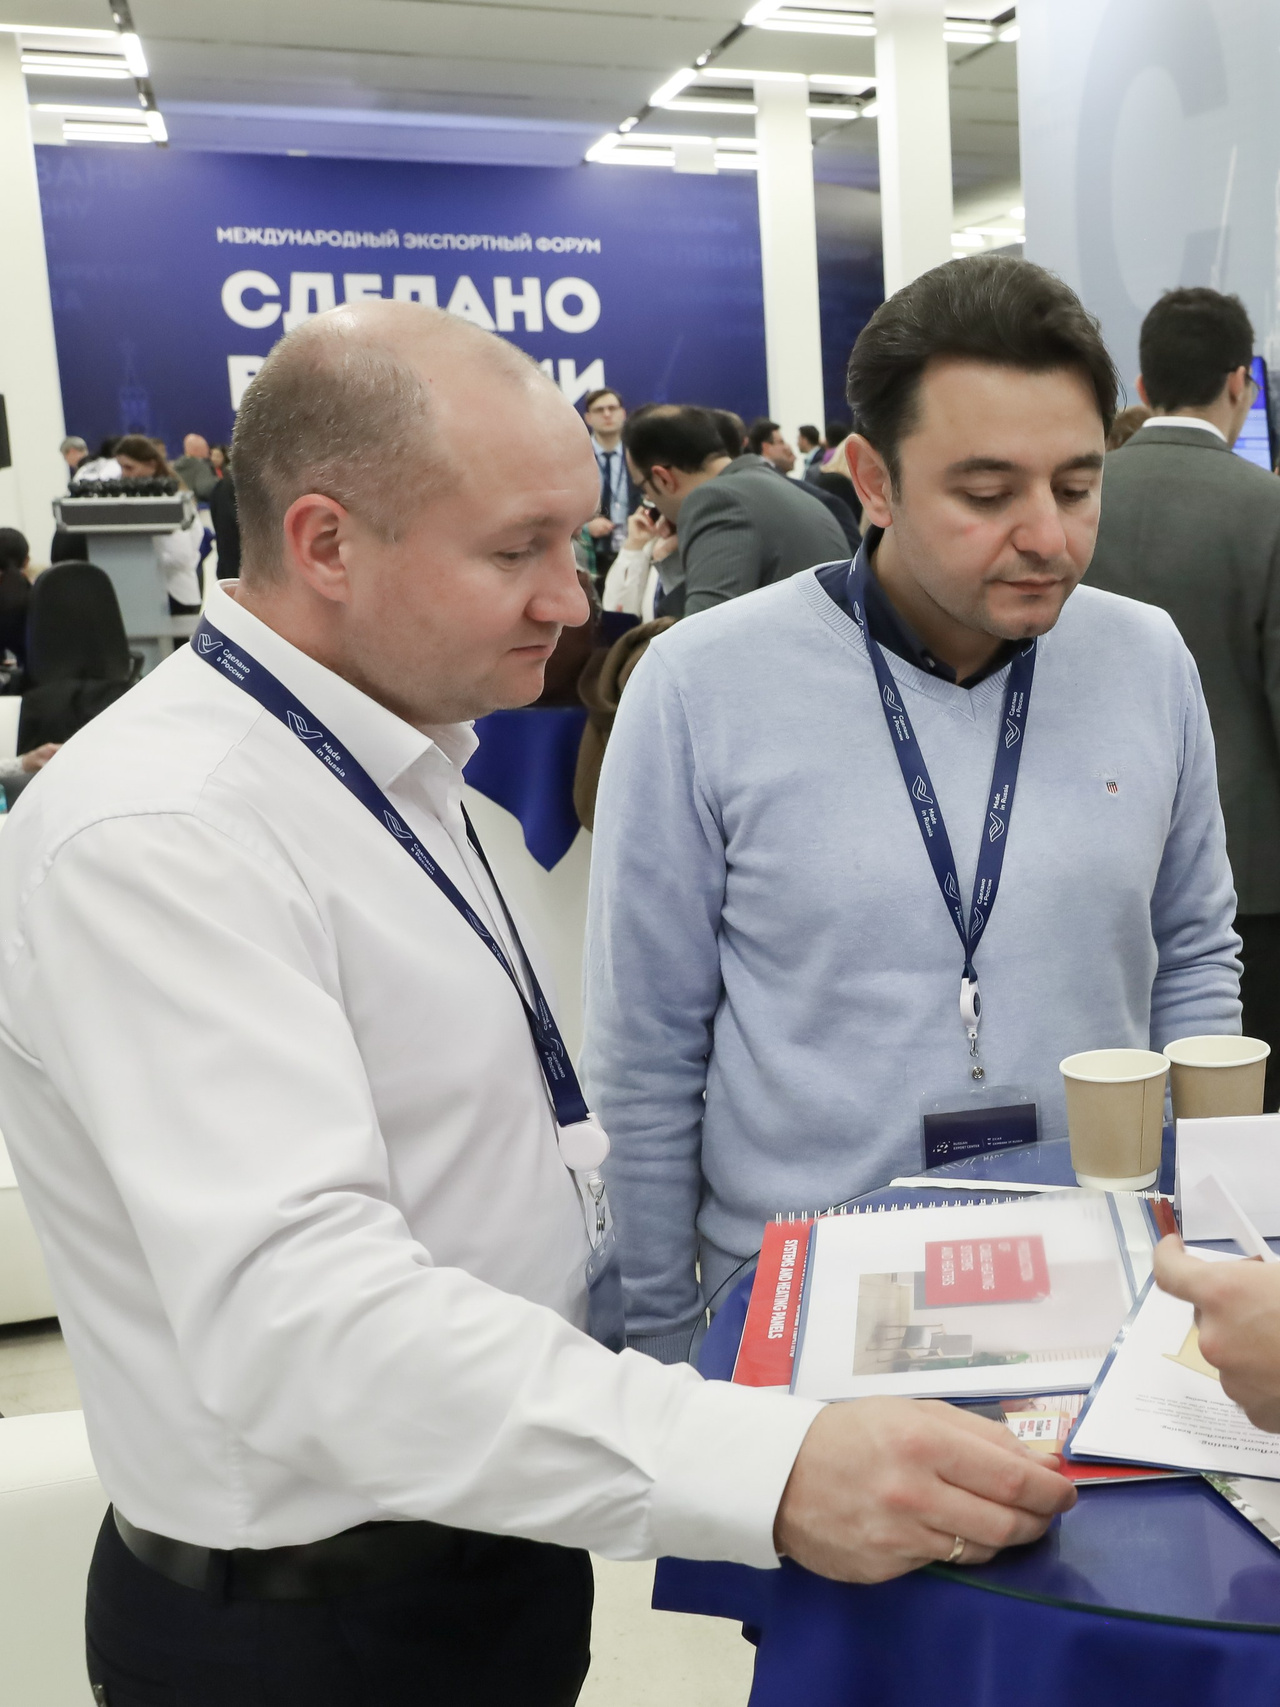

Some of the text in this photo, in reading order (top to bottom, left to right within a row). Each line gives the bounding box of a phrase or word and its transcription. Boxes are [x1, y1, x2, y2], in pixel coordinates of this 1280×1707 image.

[216, 226, 602, 254] МЕЖДУНАРОДНЫЙ ЭКСПОРТНЫЙ ФОРУМ
[221, 658, 245, 681] России
[222, 648, 251, 674] Сделано
[316, 747, 346, 778] in Russia
[322, 741, 341, 762] Made
[993, 793, 1001, 809] Made
[1001, 784, 1010, 804] Russia
[923, 817, 933, 838] Russia
[928, 808, 937, 825] Made
[780, 1239, 799, 1268] SYSTEMS
[778, 1267, 794, 1282] AND
[772, 1281, 792, 1312] HEATING
[767, 1311, 787, 1339] PANELS
